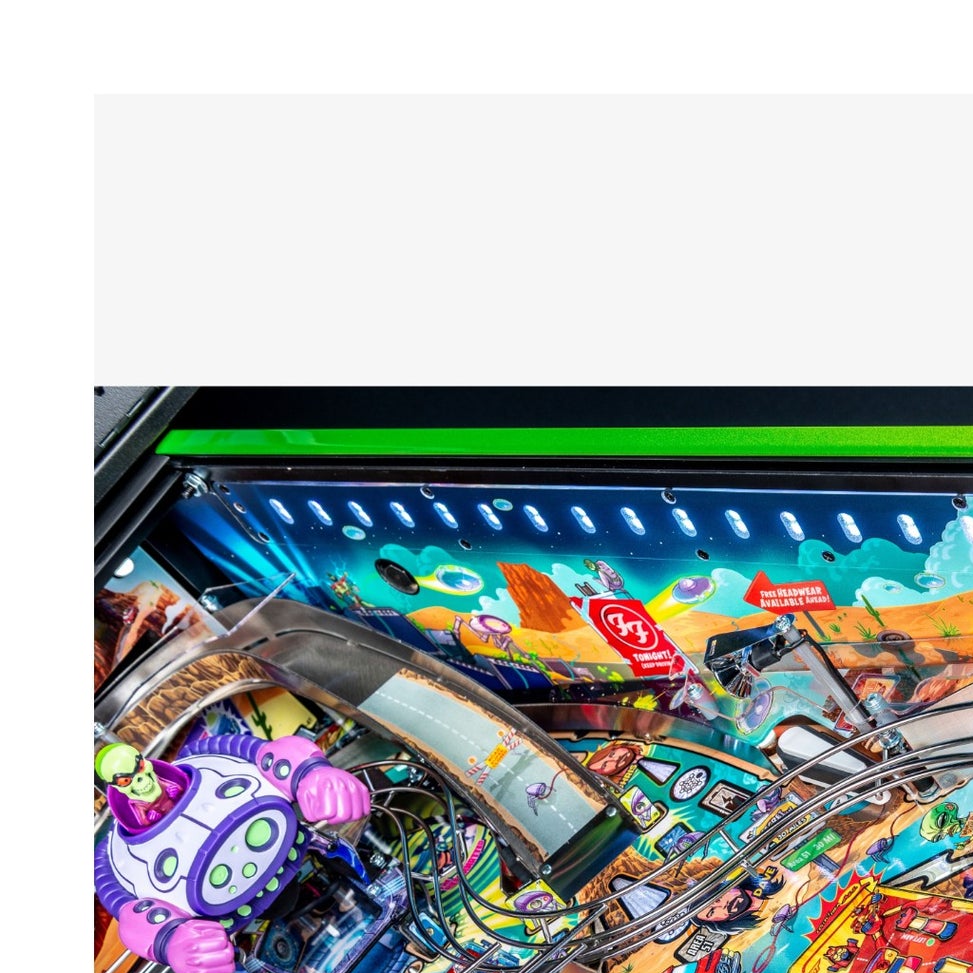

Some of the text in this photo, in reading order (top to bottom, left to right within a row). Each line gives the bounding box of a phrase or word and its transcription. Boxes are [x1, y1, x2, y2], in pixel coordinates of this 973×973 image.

[760, 586, 822, 599] FREE HEADWEAR
[760, 597, 804, 608] AVAILABLE
[632, 649, 673, 662] TONIGHT!
[752, 866, 777, 898] DAVE
[686, 933, 706, 956] AREA
[700, 939, 714, 952] 51
